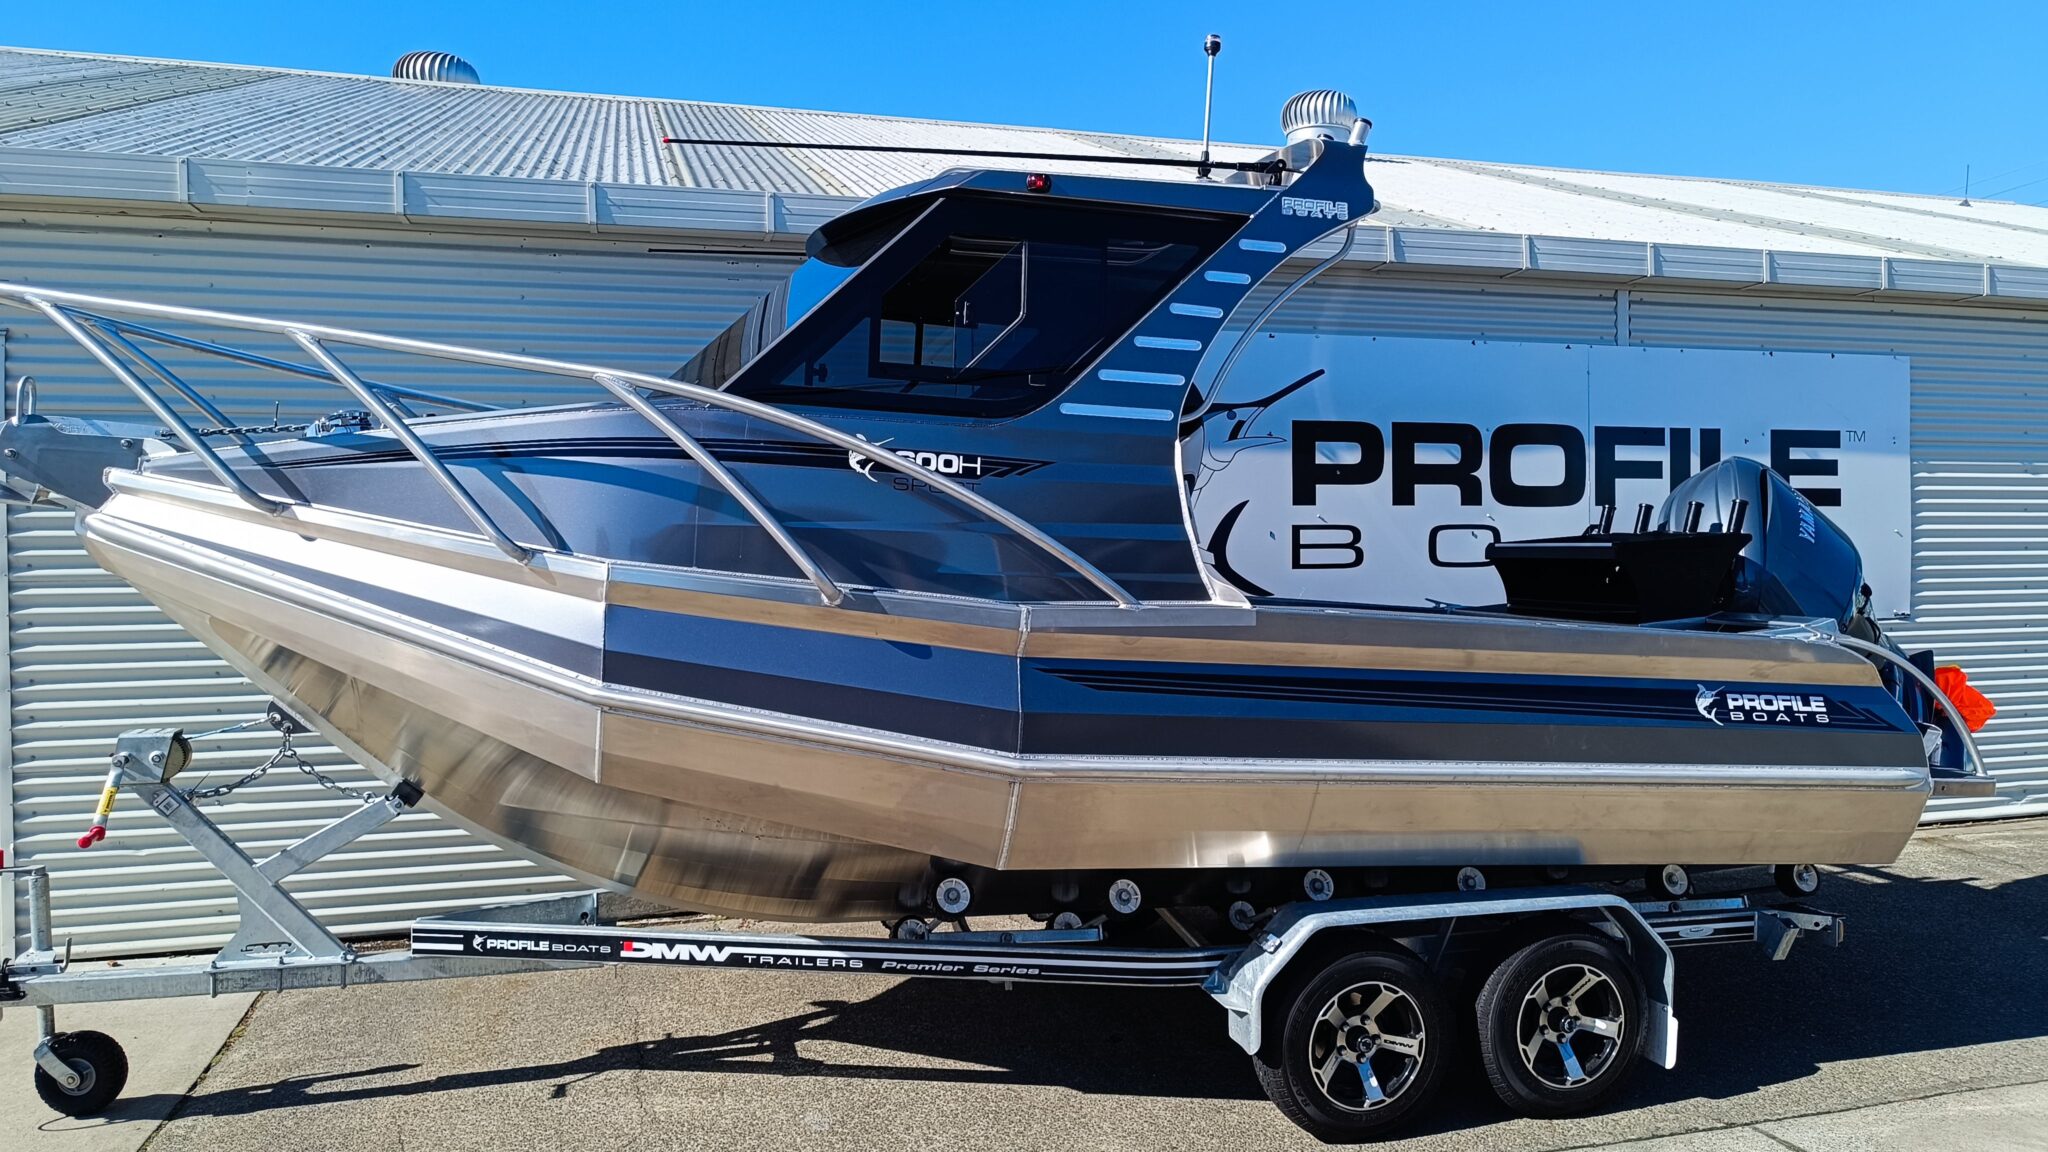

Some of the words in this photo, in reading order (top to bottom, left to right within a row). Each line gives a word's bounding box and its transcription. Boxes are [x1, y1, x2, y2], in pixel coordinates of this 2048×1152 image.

[1282, 197, 1348, 214] PROFILE
[1282, 207, 1348, 220] BOATS
[1726, 693, 1827, 712] PROFILE
[1730, 712, 1829, 723] BOATS
[486, 939, 550, 951] PROFILE
[552, 943, 612, 953] BOATS
[619, 940, 732, 962] DMW
[743, 955, 864, 968] TRAILERS
[881, 961, 964, 972] Premier
[973, 964, 1040, 975] Series
